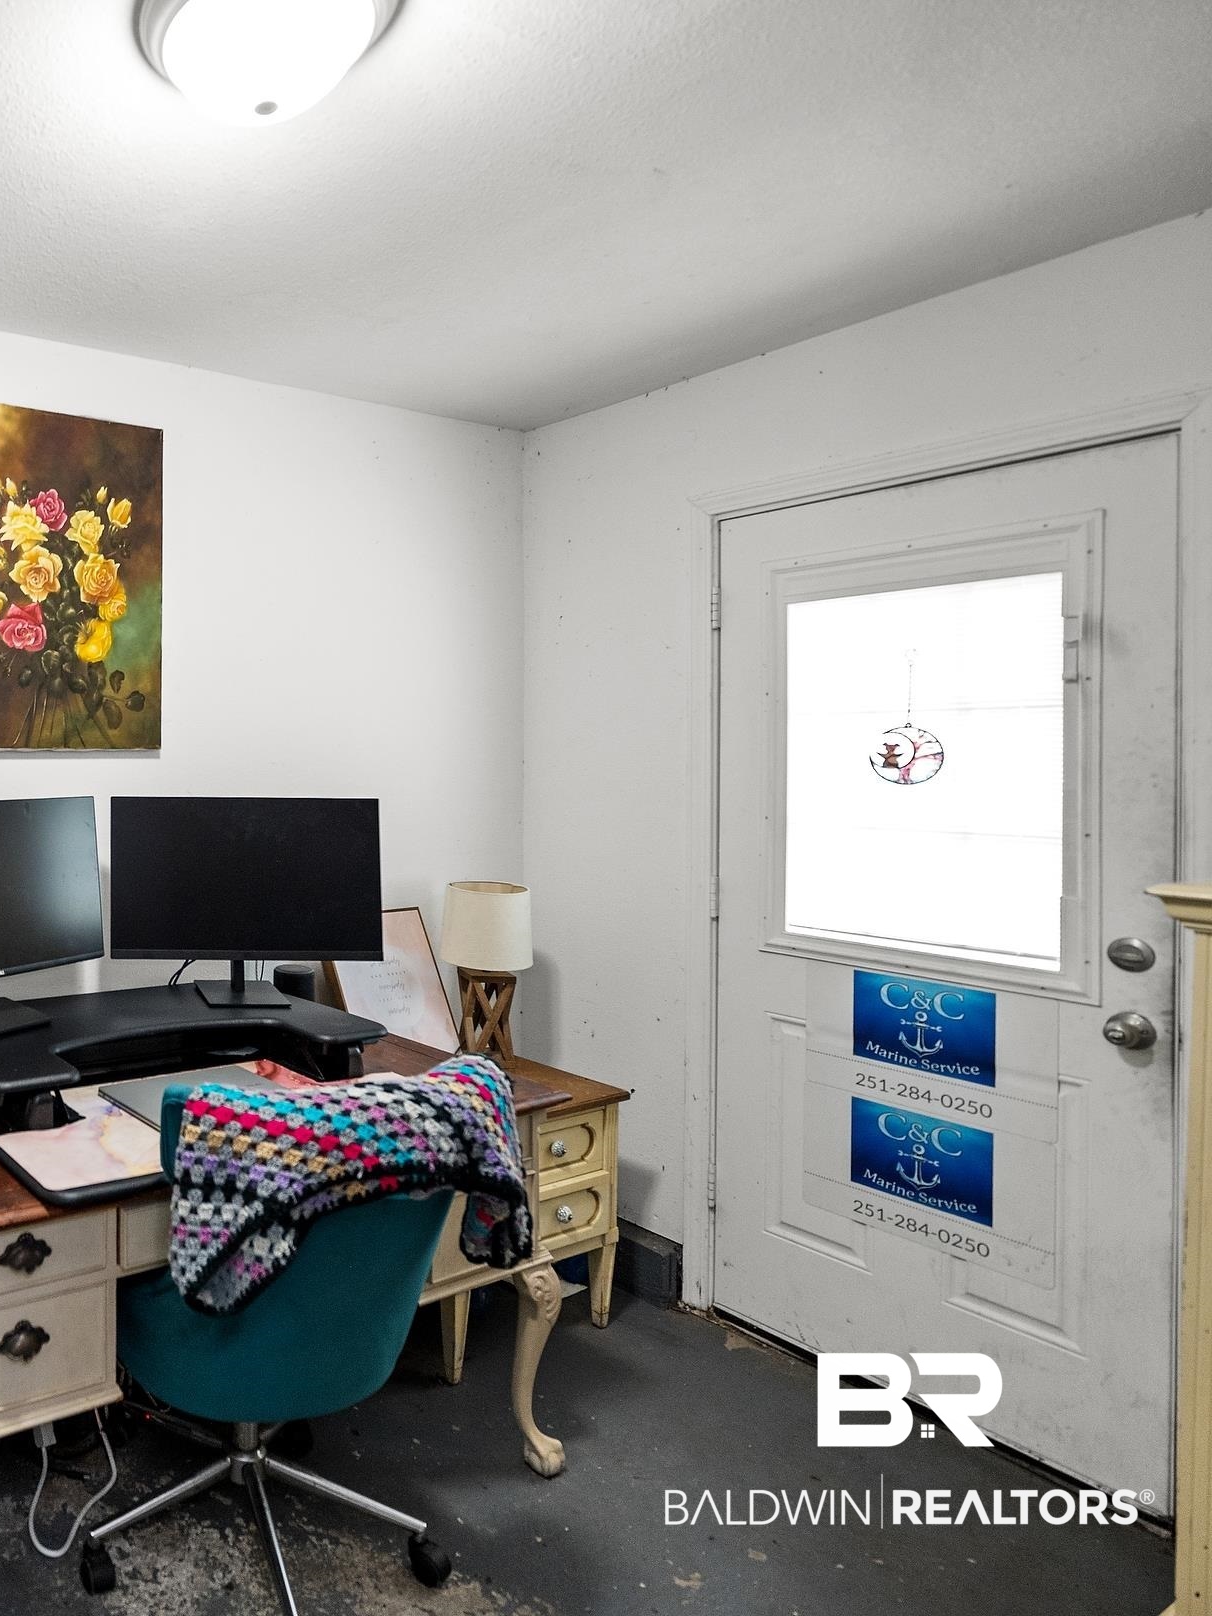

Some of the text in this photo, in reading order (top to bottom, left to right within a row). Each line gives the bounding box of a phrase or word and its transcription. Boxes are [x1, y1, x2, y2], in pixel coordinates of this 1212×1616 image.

[879, 983, 964, 1020] C&C
[865, 1040, 981, 1076] Marine Service
[854, 1073, 993, 1118] 251-284-0250
[877, 1112, 962, 1156] C&C
[863, 1168, 978, 1214] Marine Service
[853, 1200, 990, 1258] 251-284-0250
